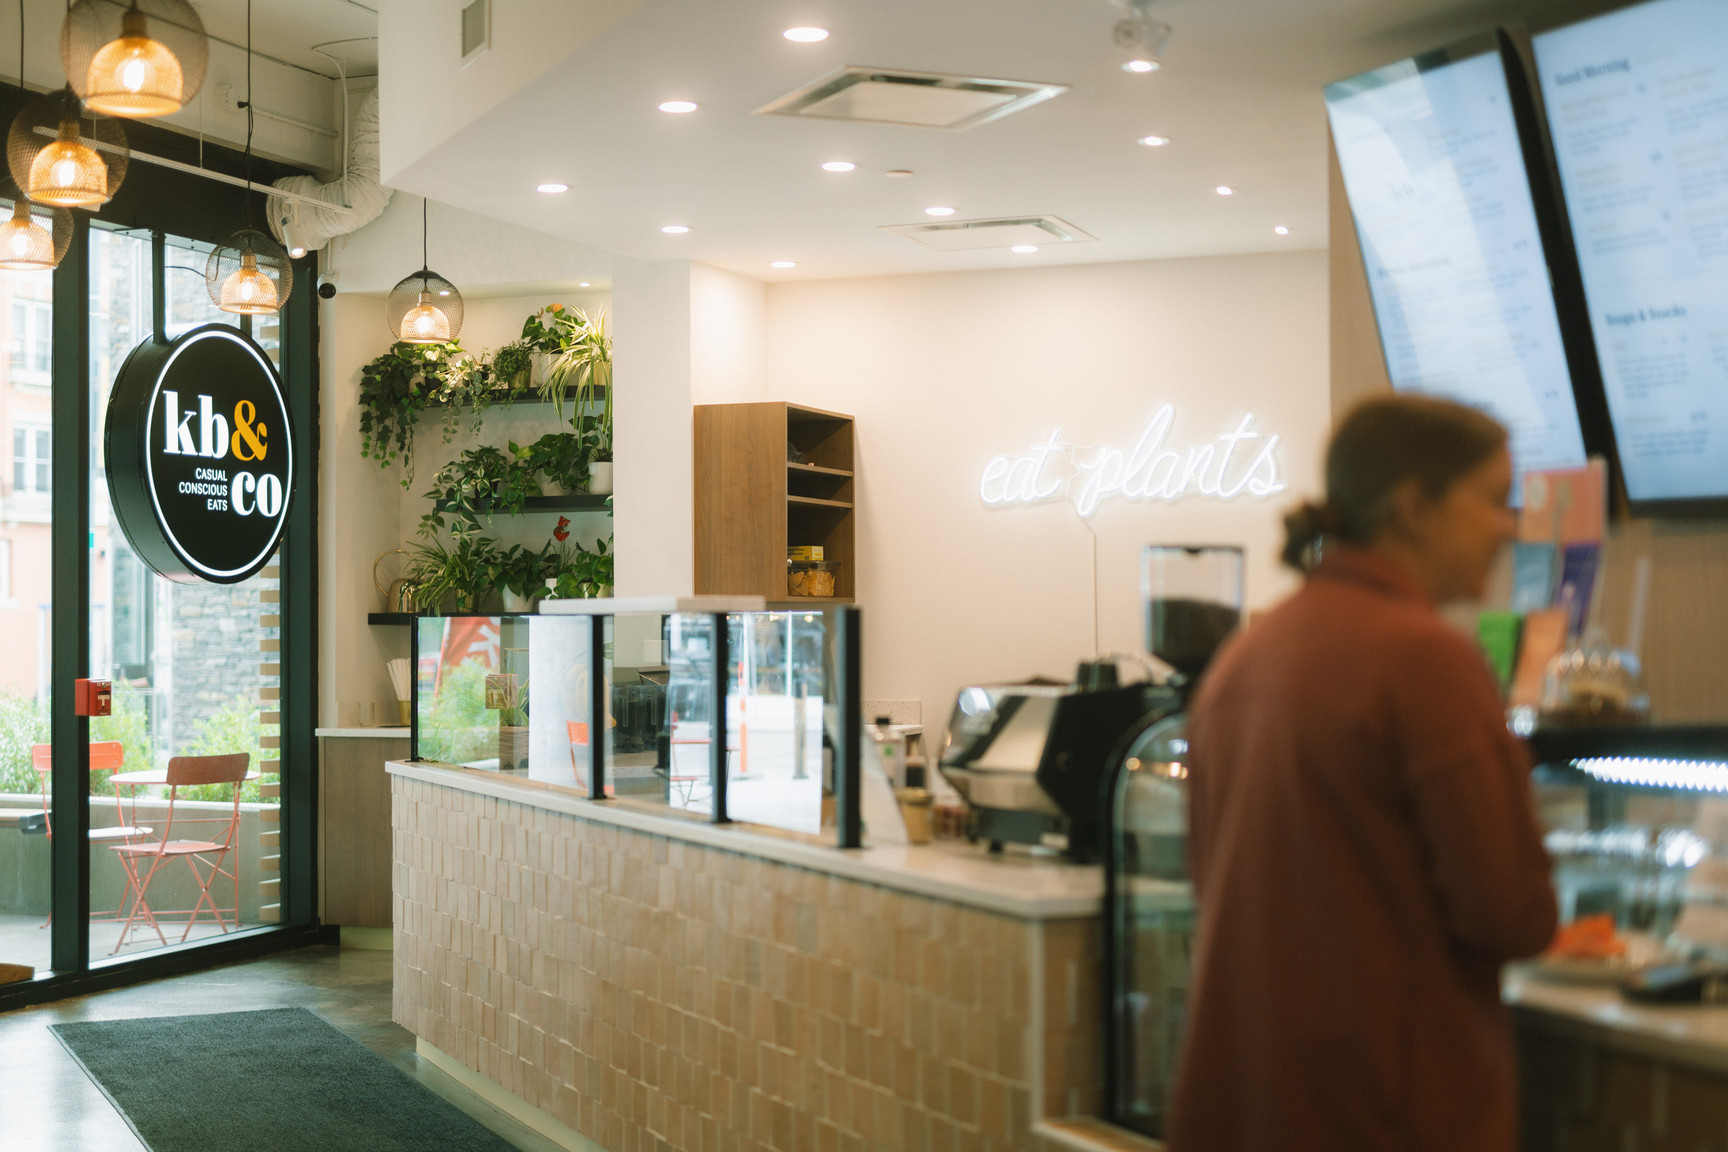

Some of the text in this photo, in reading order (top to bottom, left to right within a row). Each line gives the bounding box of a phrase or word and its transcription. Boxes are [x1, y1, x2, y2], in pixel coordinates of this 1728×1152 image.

[980, 403, 1285, 517] eat plants
[195, 467, 228, 481] CASUAL
[178, 481, 228, 496] CONSCIOUS
[206, 498, 228, 512] EATS
